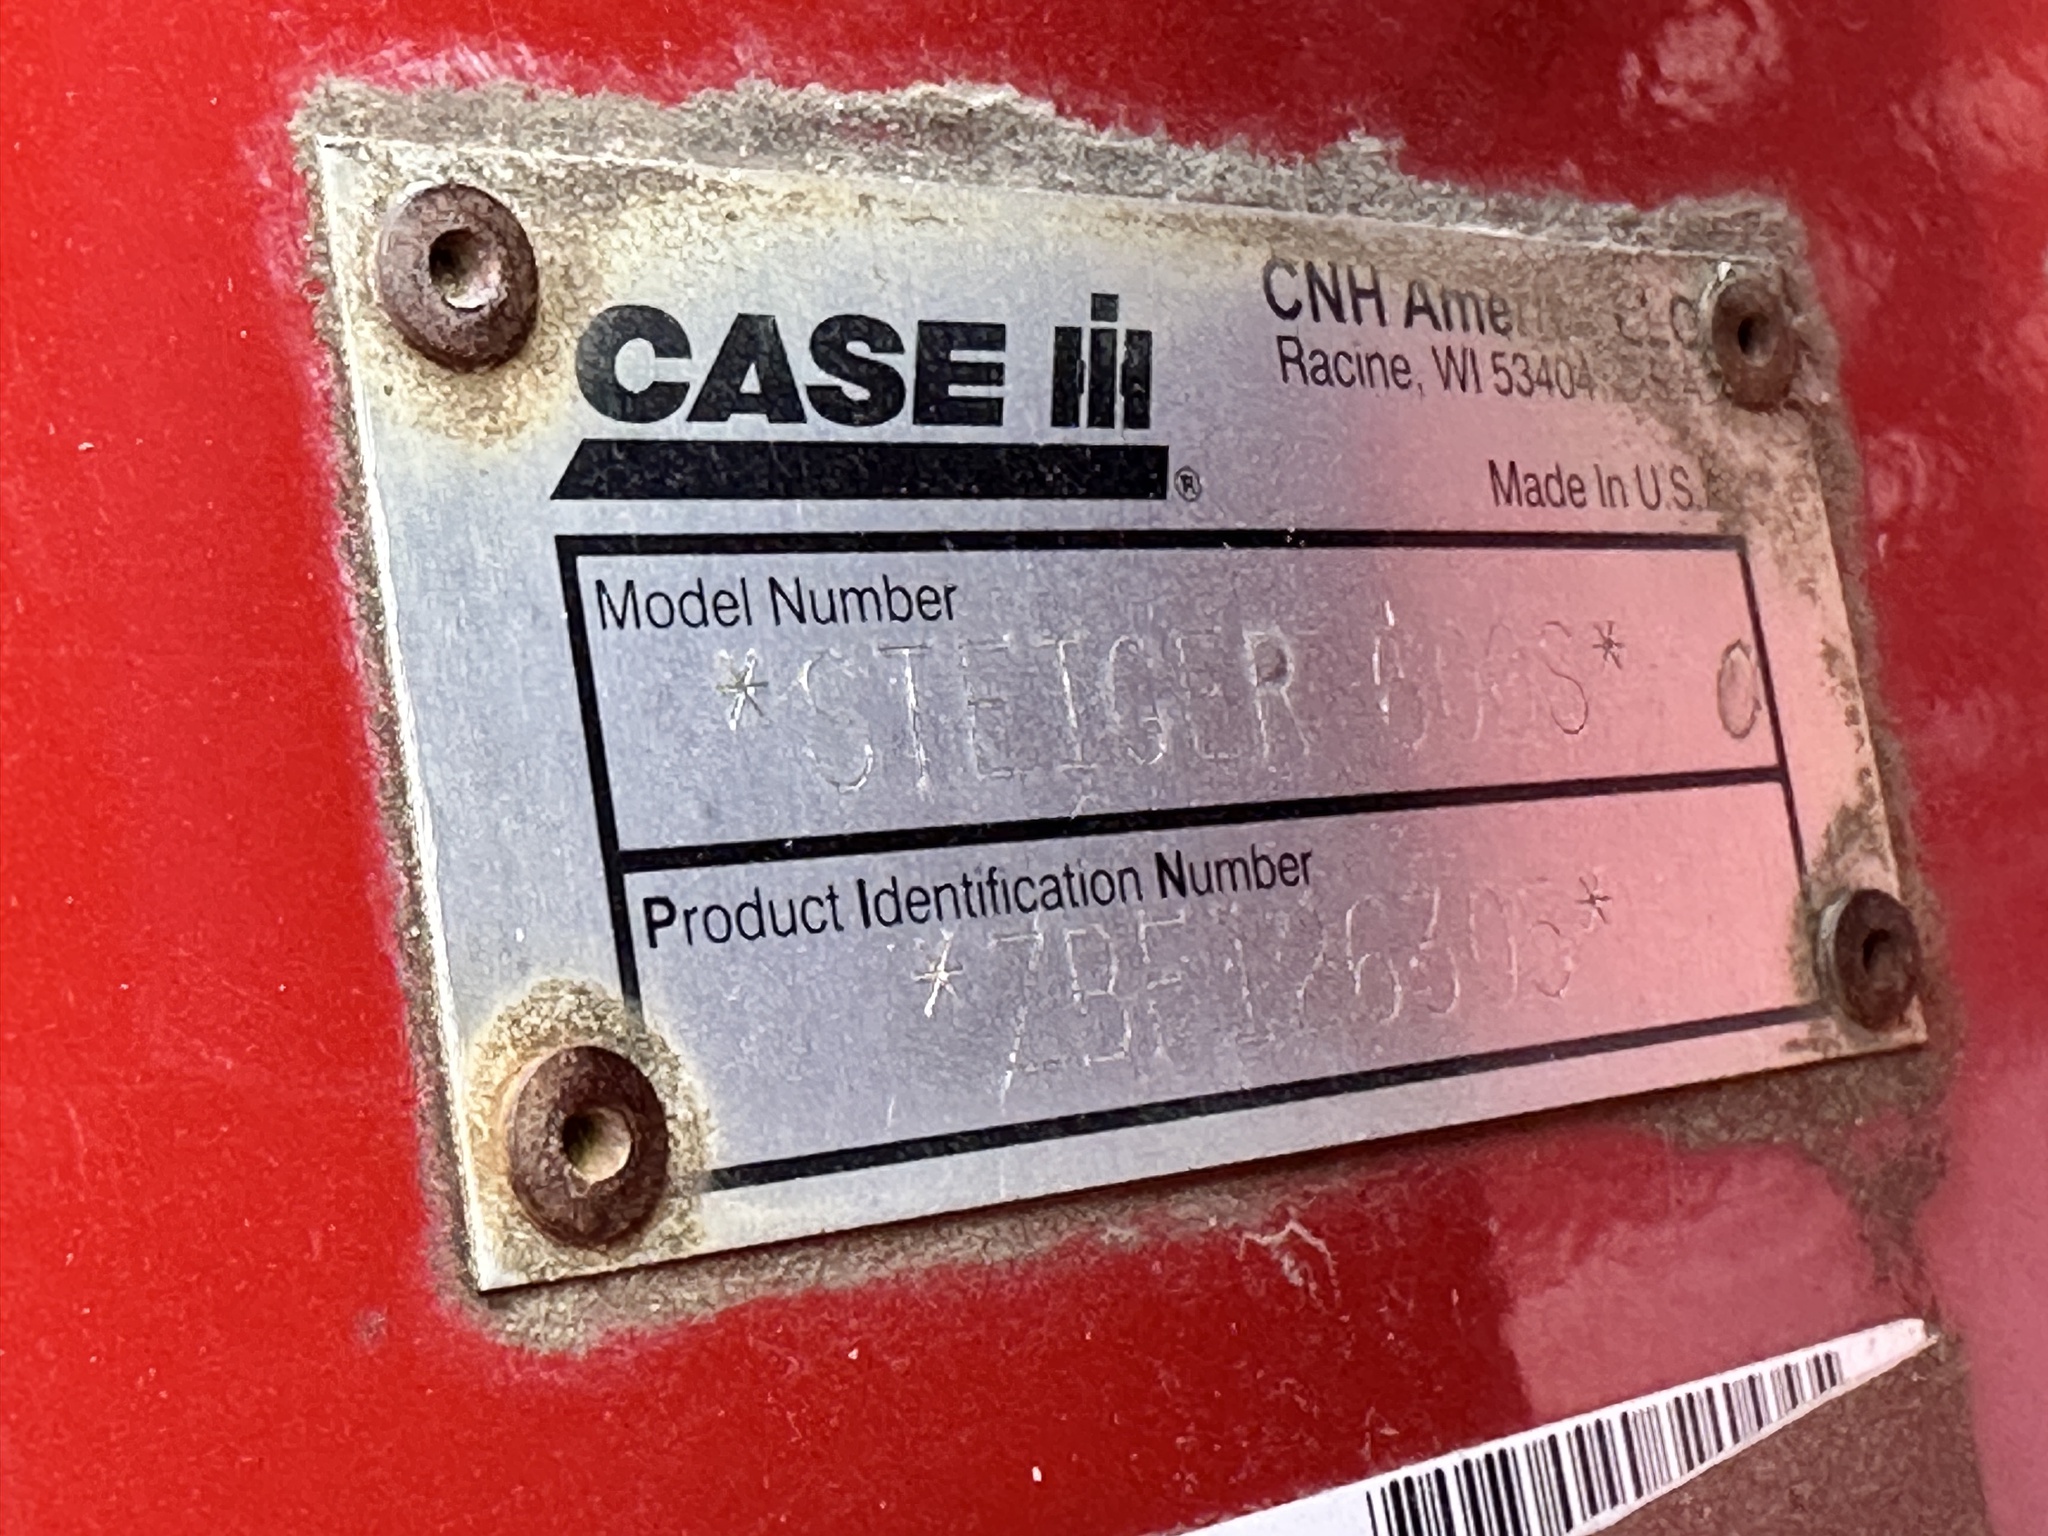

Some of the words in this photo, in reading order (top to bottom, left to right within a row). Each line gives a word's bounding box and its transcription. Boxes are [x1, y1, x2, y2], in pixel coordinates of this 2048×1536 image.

[1262, 259, 1388, 328] CNH
[575, 304, 1006, 427] CASE
[1276, 334, 1425, 400] Racine,
[1431, 345, 1485, 394] WI
[1488, 459, 1587, 510] Made
[1594, 462, 1628, 509] In
[594, 576, 753, 632] Model
[769, 573, 958, 628] Number
[642, 882, 845, 950] Product
[856, 861, 1144, 931] Identification
[1153, 843, 1314, 900] Number
